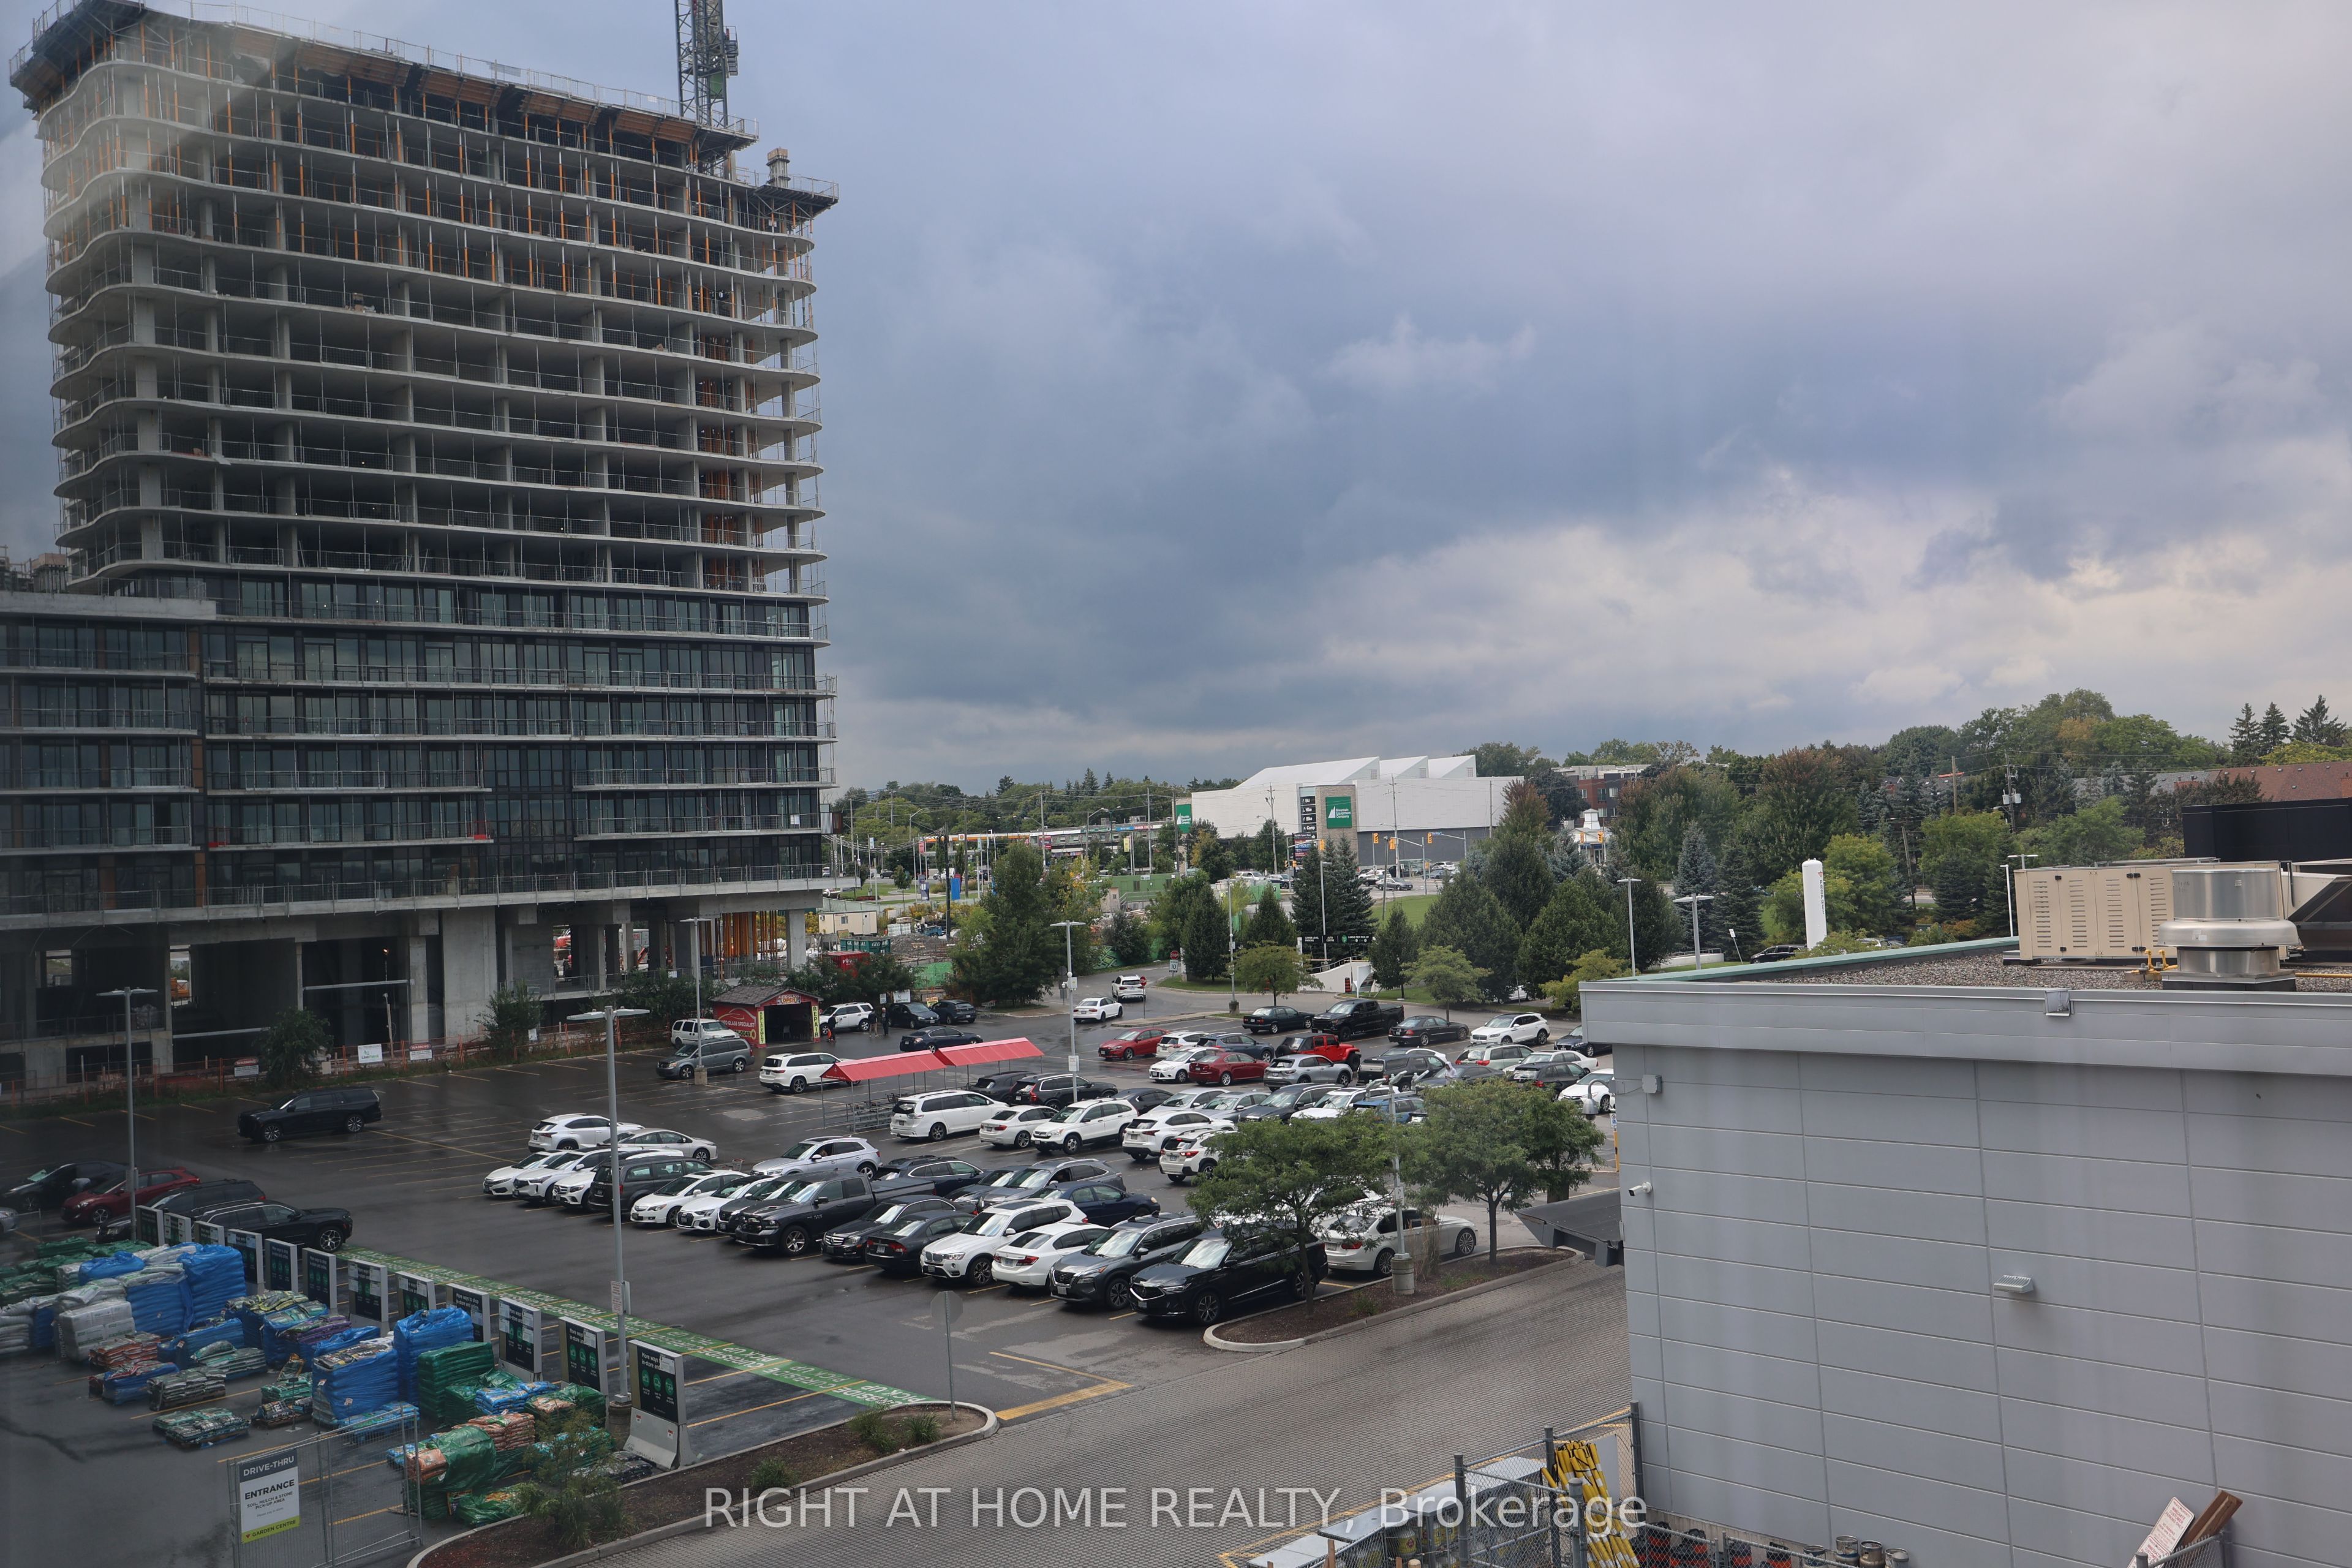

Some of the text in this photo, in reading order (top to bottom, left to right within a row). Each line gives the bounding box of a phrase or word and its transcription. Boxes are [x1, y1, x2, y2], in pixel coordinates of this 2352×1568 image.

[642, 1359, 654, 1368] in-store
[698, 1348, 765, 1369] CURBSIDE
[744, 1351, 779, 1363] PICK
[763, 1367, 837, 1389] CURBSIDE
[813, 1371, 850, 1383] PICK
[861, 1385, 927, 1403] PICK UP
[243, 1456, 295, 1477] DRIVE-THRU
[245, 1479, 295, 1500] ENTRANCE
[255, 1498, 285, 1510] PICK-UP AREA
[259, 1497, 275, 1506] MULCH
[252, 1519, 296, 1537] GARDEN CENTRE
